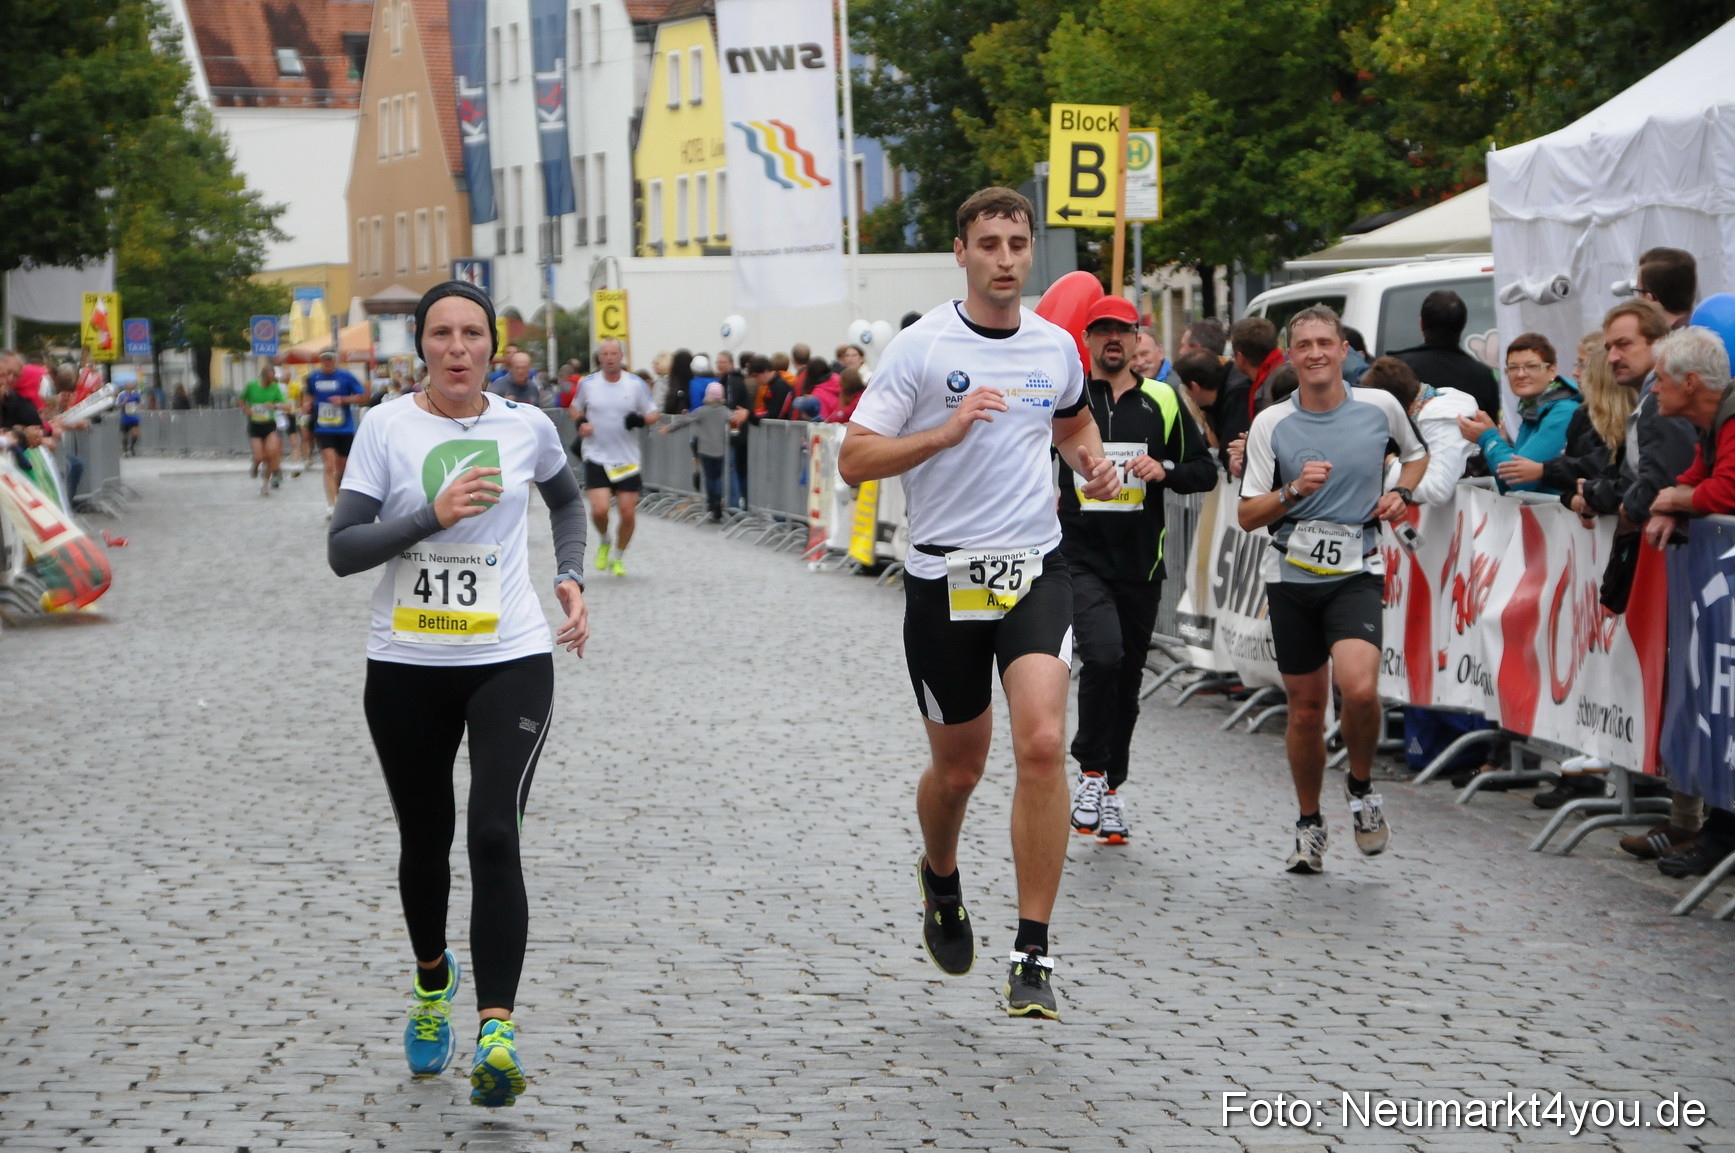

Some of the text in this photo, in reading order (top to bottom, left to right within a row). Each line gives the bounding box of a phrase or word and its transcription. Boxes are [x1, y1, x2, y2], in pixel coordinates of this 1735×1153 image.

[1061, 109, 1120, 132] Block
[1069, 141, 1107, 198] B
[85, 293, 113, 304] Blck
[596, 291, 625, 302] Block
[602, 305, 620, 331] C
[128, 343, 147, 352] TAXI
[254, 343, 275, 352] TAXI
[401, 552, 481, 565] ARTL Neumarkt
[1310, 539, 1343, 566] 45
[969, 559, 1026, 591] 525
[413, 568, 478, 607] 413
[418, 614, 468, 631] Bettina
